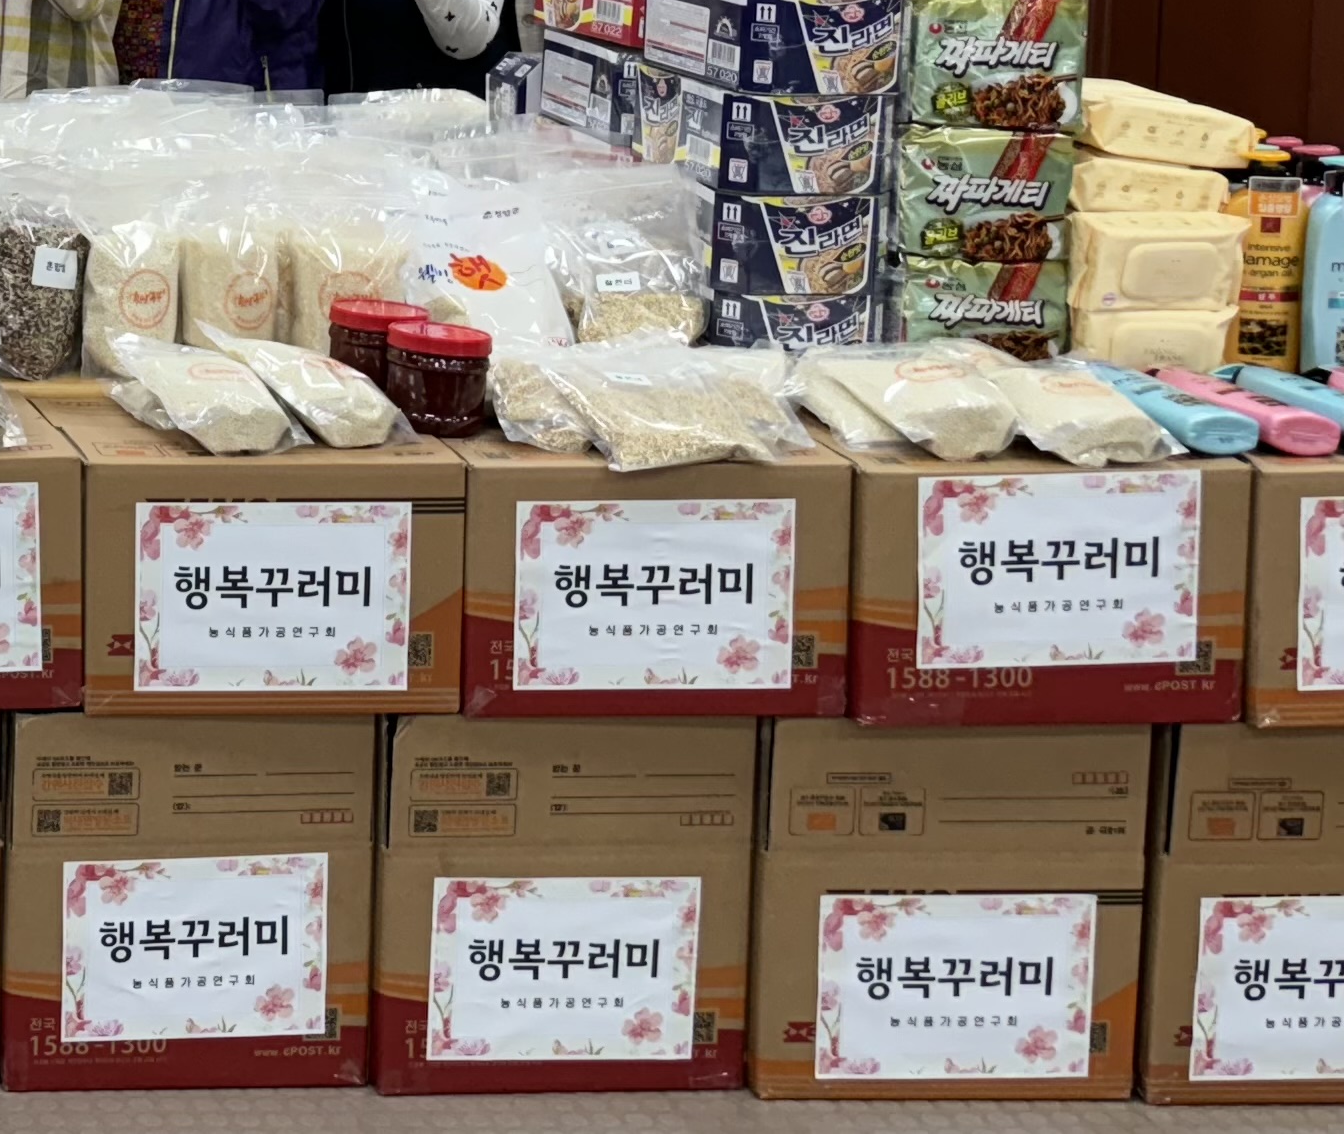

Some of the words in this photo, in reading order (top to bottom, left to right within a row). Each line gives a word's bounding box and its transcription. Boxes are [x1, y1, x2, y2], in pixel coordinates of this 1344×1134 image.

[813, 12, 895, 55] 진라면
[707, 65, 738, 85] 57020
[937, 36, 1059, 77] 짜파게티
[789, 112, 871, 154] 진라면
[927, 173, 1050, 216] 짜파게티
[779, 216, 864, 257] 진라면
[777, 312, 860, 348] 진라면
[929, 292, 1045, 329] 짜파게티
[958, 536, 1159, 586] 행복꾸러미
[173, 565, 371, 610] 행복꾸러미
[554, 563, 754, 608] 행복꾸러미
[884, 666, 1034, 691] 1588-1300
[99, 915, 288, 964] 행복꾸러미
[468, 938, 660, 982] 행복꾸러미
[856, 956, 1054, 1001] 행복꾸러미
